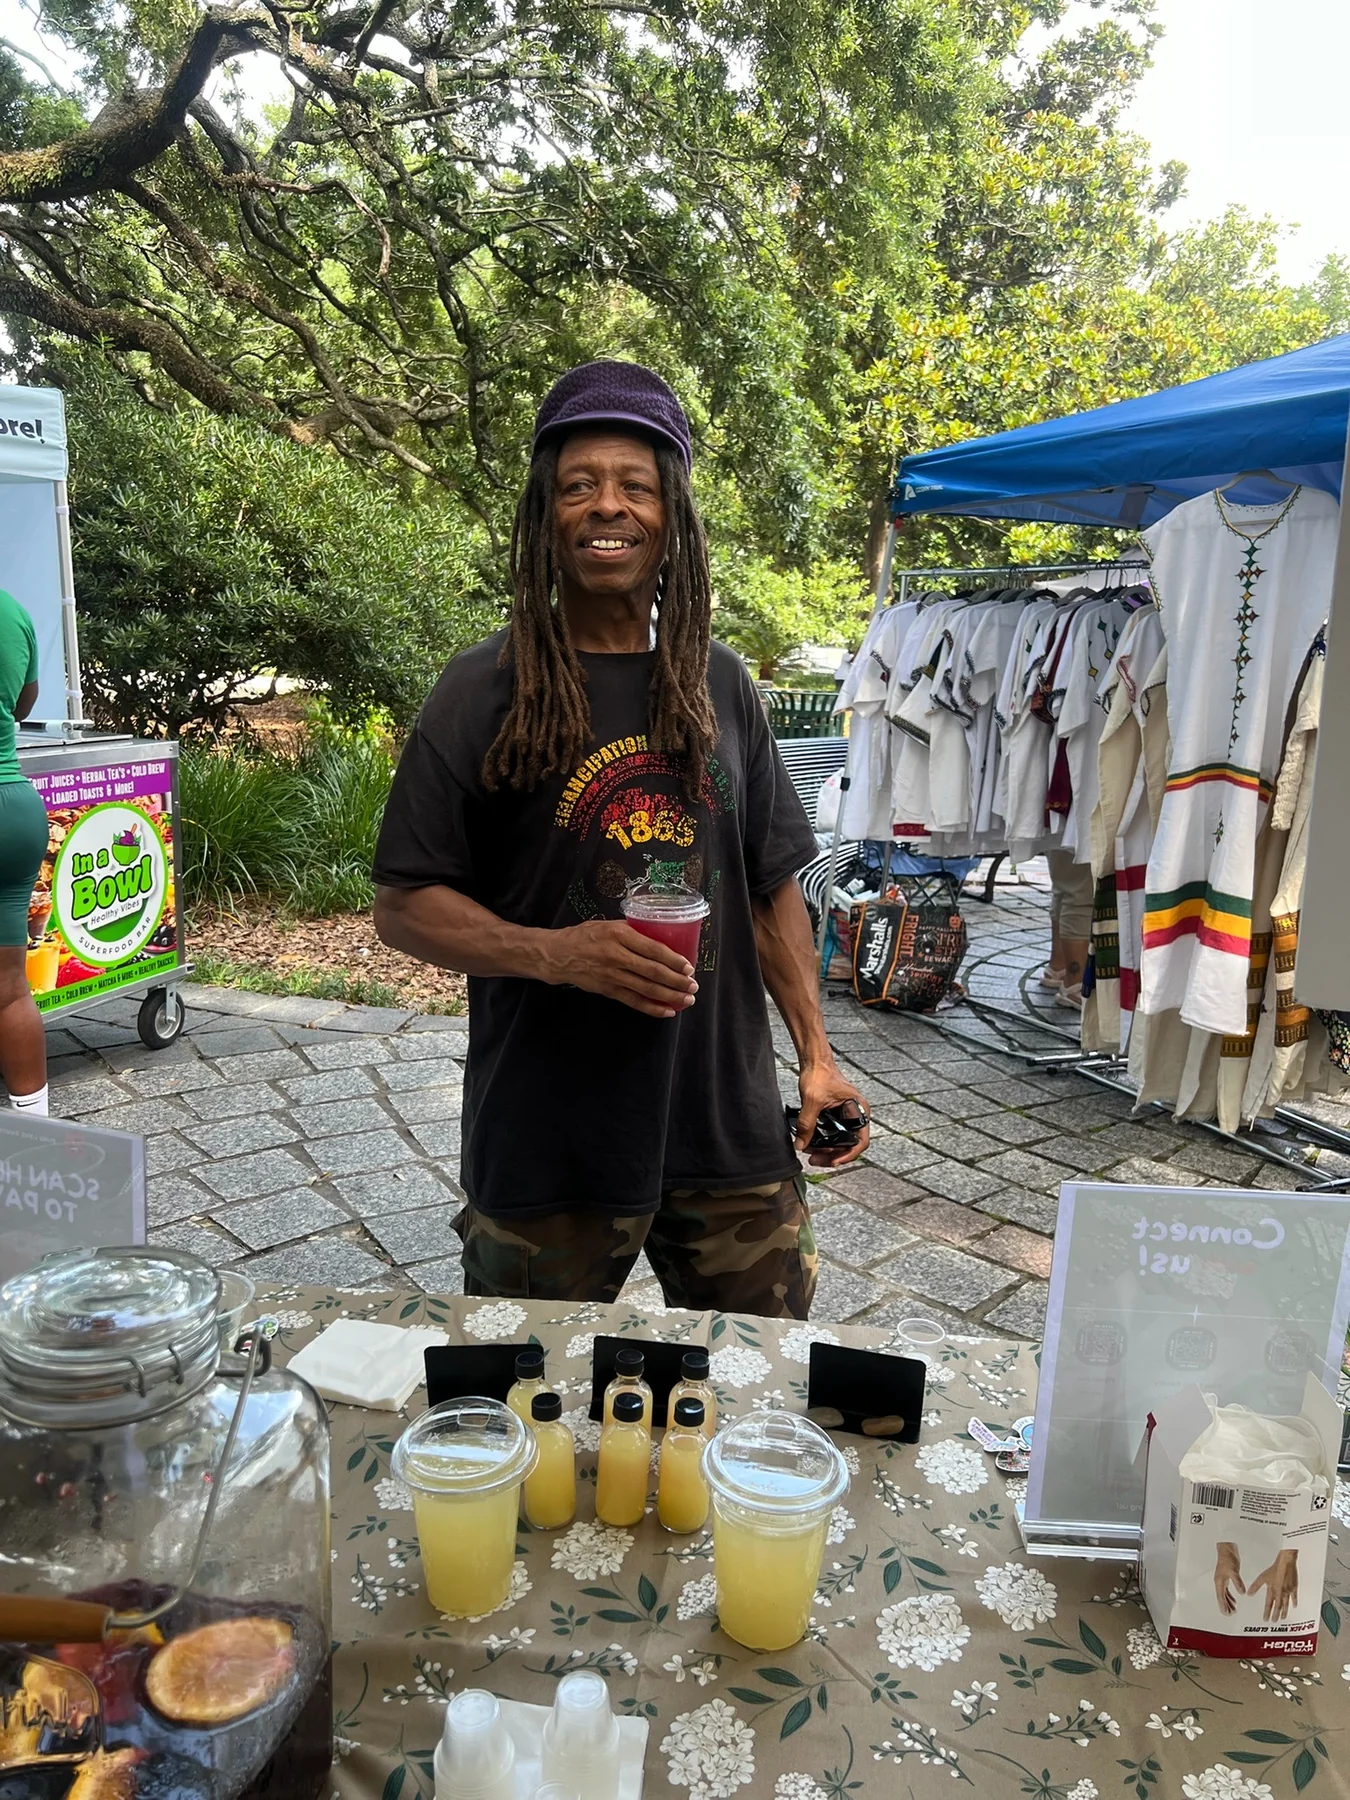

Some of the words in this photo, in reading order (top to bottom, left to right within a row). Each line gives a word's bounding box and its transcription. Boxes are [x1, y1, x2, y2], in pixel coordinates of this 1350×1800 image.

[29, 777, 48, 790] FRUIT
[50, 774, 75, 789] JUICES
[81, 770, 107, 784] HERBAL
[107, 766, 125, 780] TEA'S
[131, 764, 147, 777] COLD
[147, 762, 166, 775] BREW
[52, 790, 78, 805] LOADED
[78, 786, 104, 800] TOASTS
[106, 785, 112, 797] &
[114, 781, 134, 796] MORE!
[554, 735, 648, 827] EMANCIPATION
[605, 811, 697, 850] 1865
[72, 853, 94, 877] In
[96, 848, 109, 869] a
[71, 854, 153, 920] Bowl
[90, 908, 119, 926] Healthy
[120, 899, 140, 913] Vibes
[78, 936, 133, 955] SUPERFOOD
[136, 916, 151, 938] BAR
[859, 917, 889, 985] Marshalls
[900, 914, 919, 958] FRIGHT
[51, 995, 61, 1006] TEA
[65, 988, 79, 999] COLD
[79, 984, 94, 995] BREW
[98, 976, 117, 989] MATCHA
[117, 973, 122, 983] &
[121, 970, 134, 981] MORE
[138, 960, 157, 976] HEALTHY
[157, 954, 175, 969] SNACKS!
[1263, 1640, 1313, 1649] TOUGH
